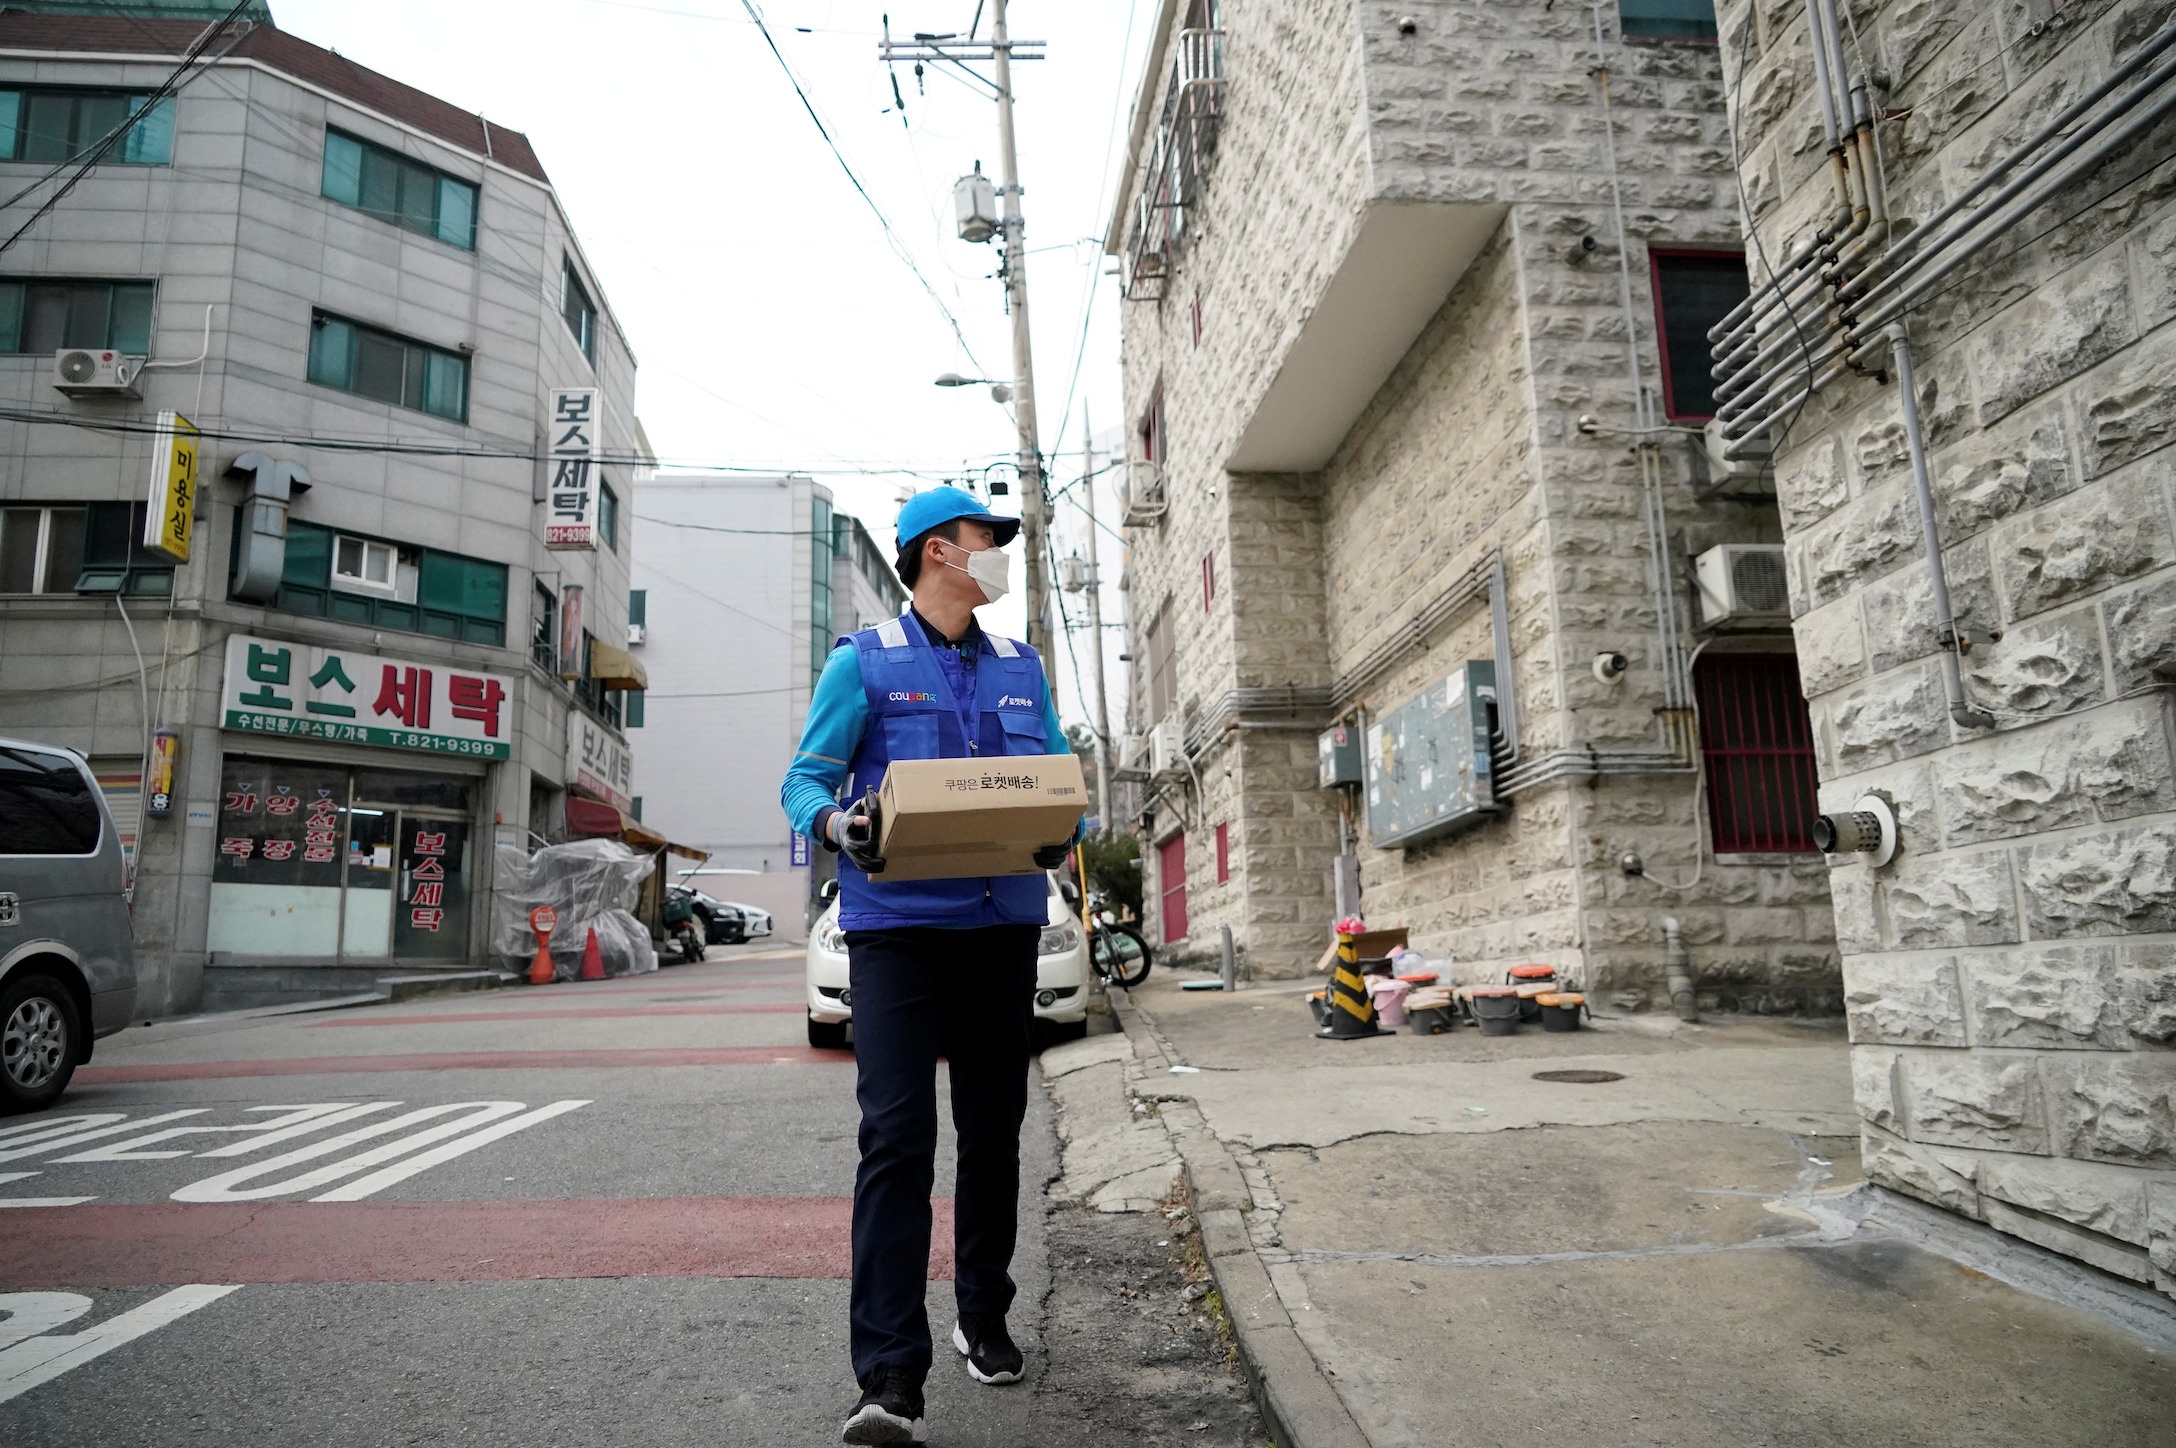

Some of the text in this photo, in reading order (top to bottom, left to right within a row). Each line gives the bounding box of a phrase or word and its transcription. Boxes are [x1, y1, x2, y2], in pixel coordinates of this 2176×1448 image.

[552, 395, 591, 522] 보스세탁
[170, 449, 191, 542] 미용실
[546, 528, 590, 542] 821-9399
[889, 691, 937, 703] coupang
[389, 731, 495, 755] T.821-9399
[582, 724, 630, 794] 보스세탁
[945, 774, 1038, 791] 쿠팡은 로켓배송!
[410, 831, 445, 931] 보스세탁
